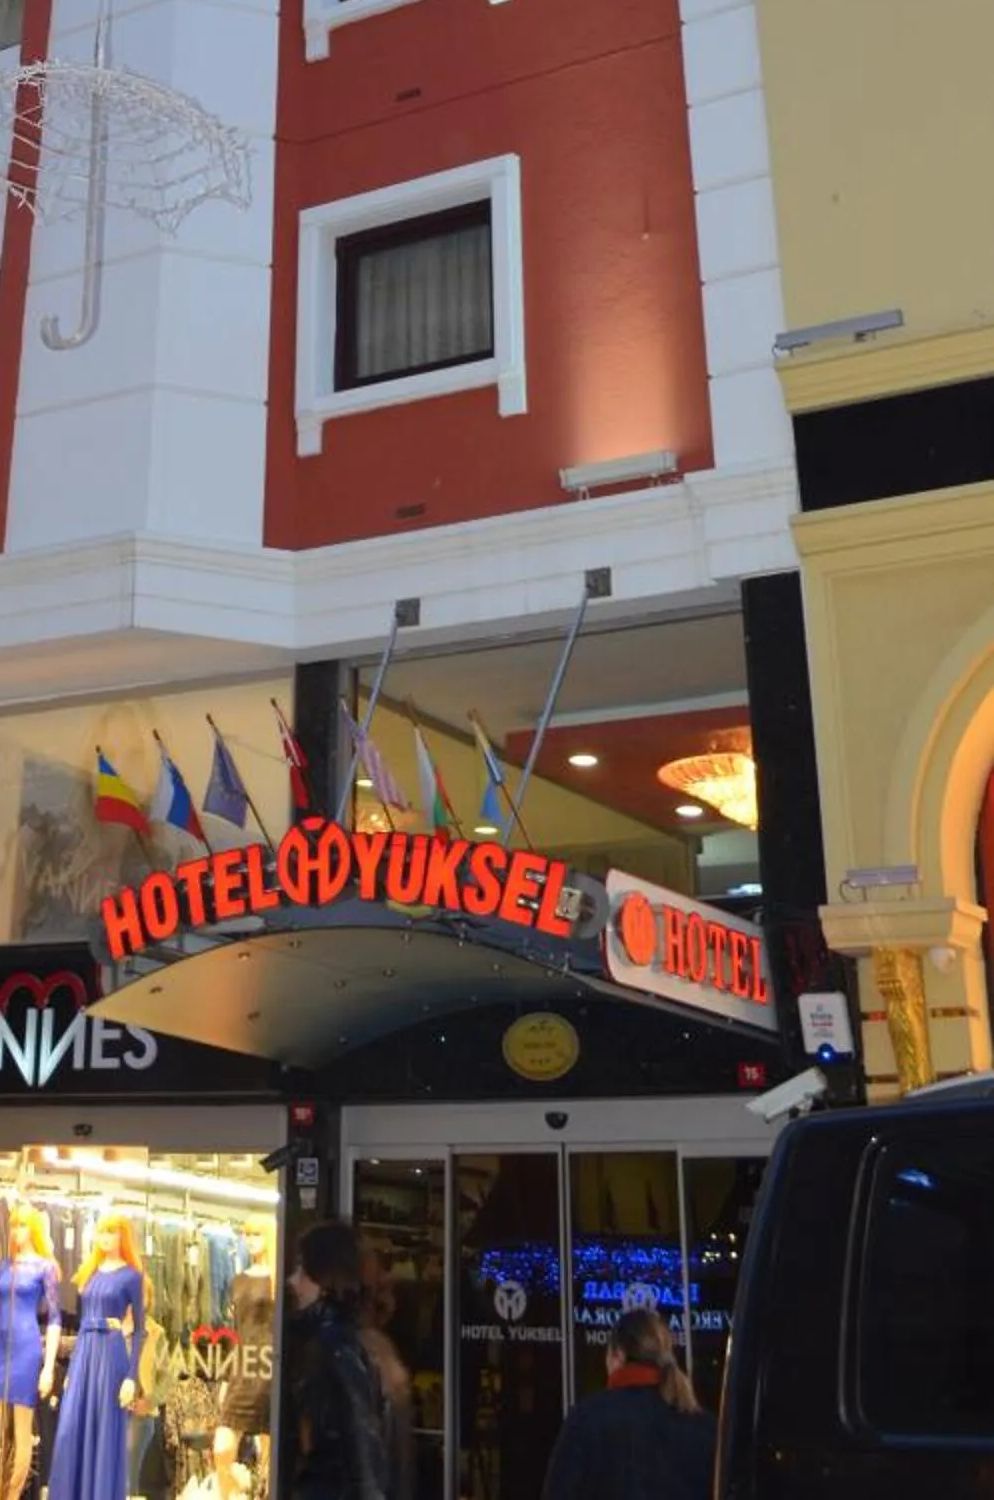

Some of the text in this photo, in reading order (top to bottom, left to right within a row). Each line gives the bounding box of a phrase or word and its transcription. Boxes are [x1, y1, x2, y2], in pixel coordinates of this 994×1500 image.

[102, 843, 280, 961] HOTEL
[662, 903, 767, 1004] HOTEL
[462, 1324, 504, 1341] HOTEL
